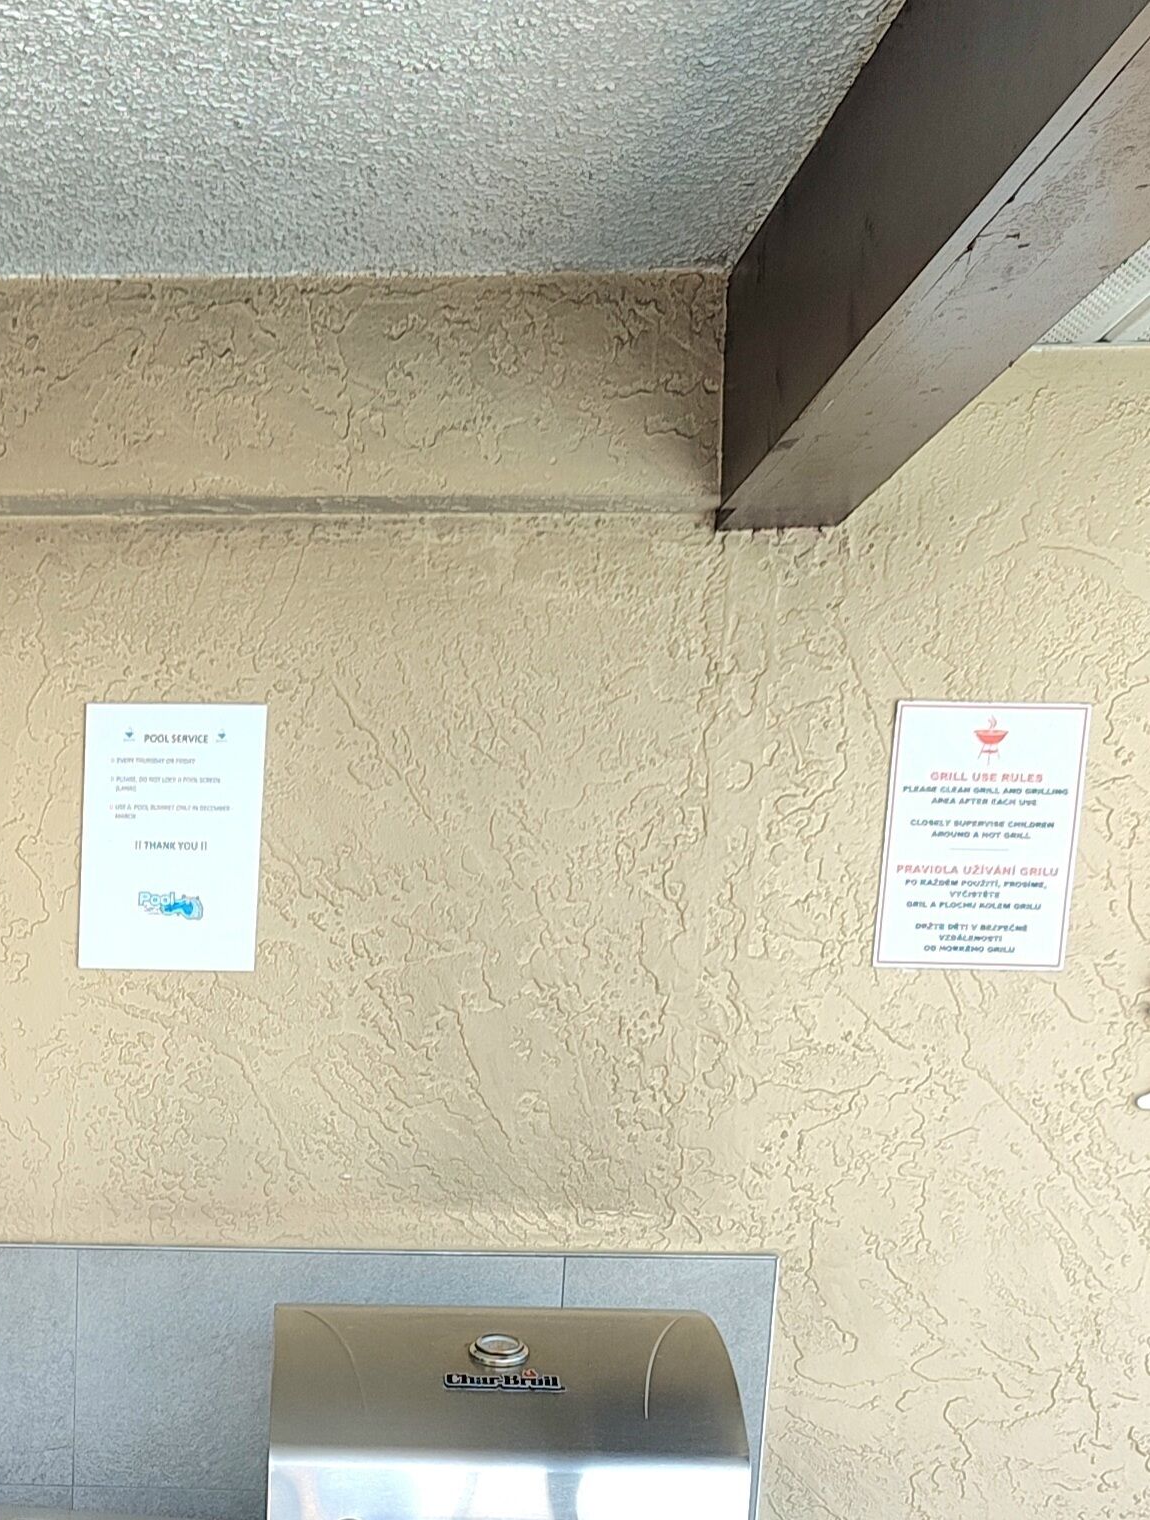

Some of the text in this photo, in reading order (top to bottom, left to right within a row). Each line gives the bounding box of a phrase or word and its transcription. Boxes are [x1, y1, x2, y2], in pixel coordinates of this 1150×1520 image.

[144, 733, 170, 744] POOL
[171, 734, 209, 744] SERVICE
[930, 771, 1043, 783] GRILL USE RULES
[902, 785, 1069, 796] PLEASE CLEAN GRILL AND GRILLING
[931, 797, 956, 805] AREA
[958, 797, 988, 805] AFTER
[991, 798, 1016, 806] EACH
[910, 818, 1055, 829] CLOSELY SUPERVISE CHILDREN
[931, 830, 1031, 839] AROUND A HOT GRILL
[143, 840, 176, 850] THANK
[177, 841, 199, 851] YOU
[896, 864, 1059, 877] PRAVIDLA UŽÍVÁNÍ GRILU
[905, 878, 918, 886] PO
[138, 891, 176, 907] Pool
[906, 900, 928, 908] GRIL
[1013, 902, 1041, 911] GRILU
[971, 923, 978, 931] V
[923, 944, 937, 952] OD
[987, 945, 1015, 953] GRILU
